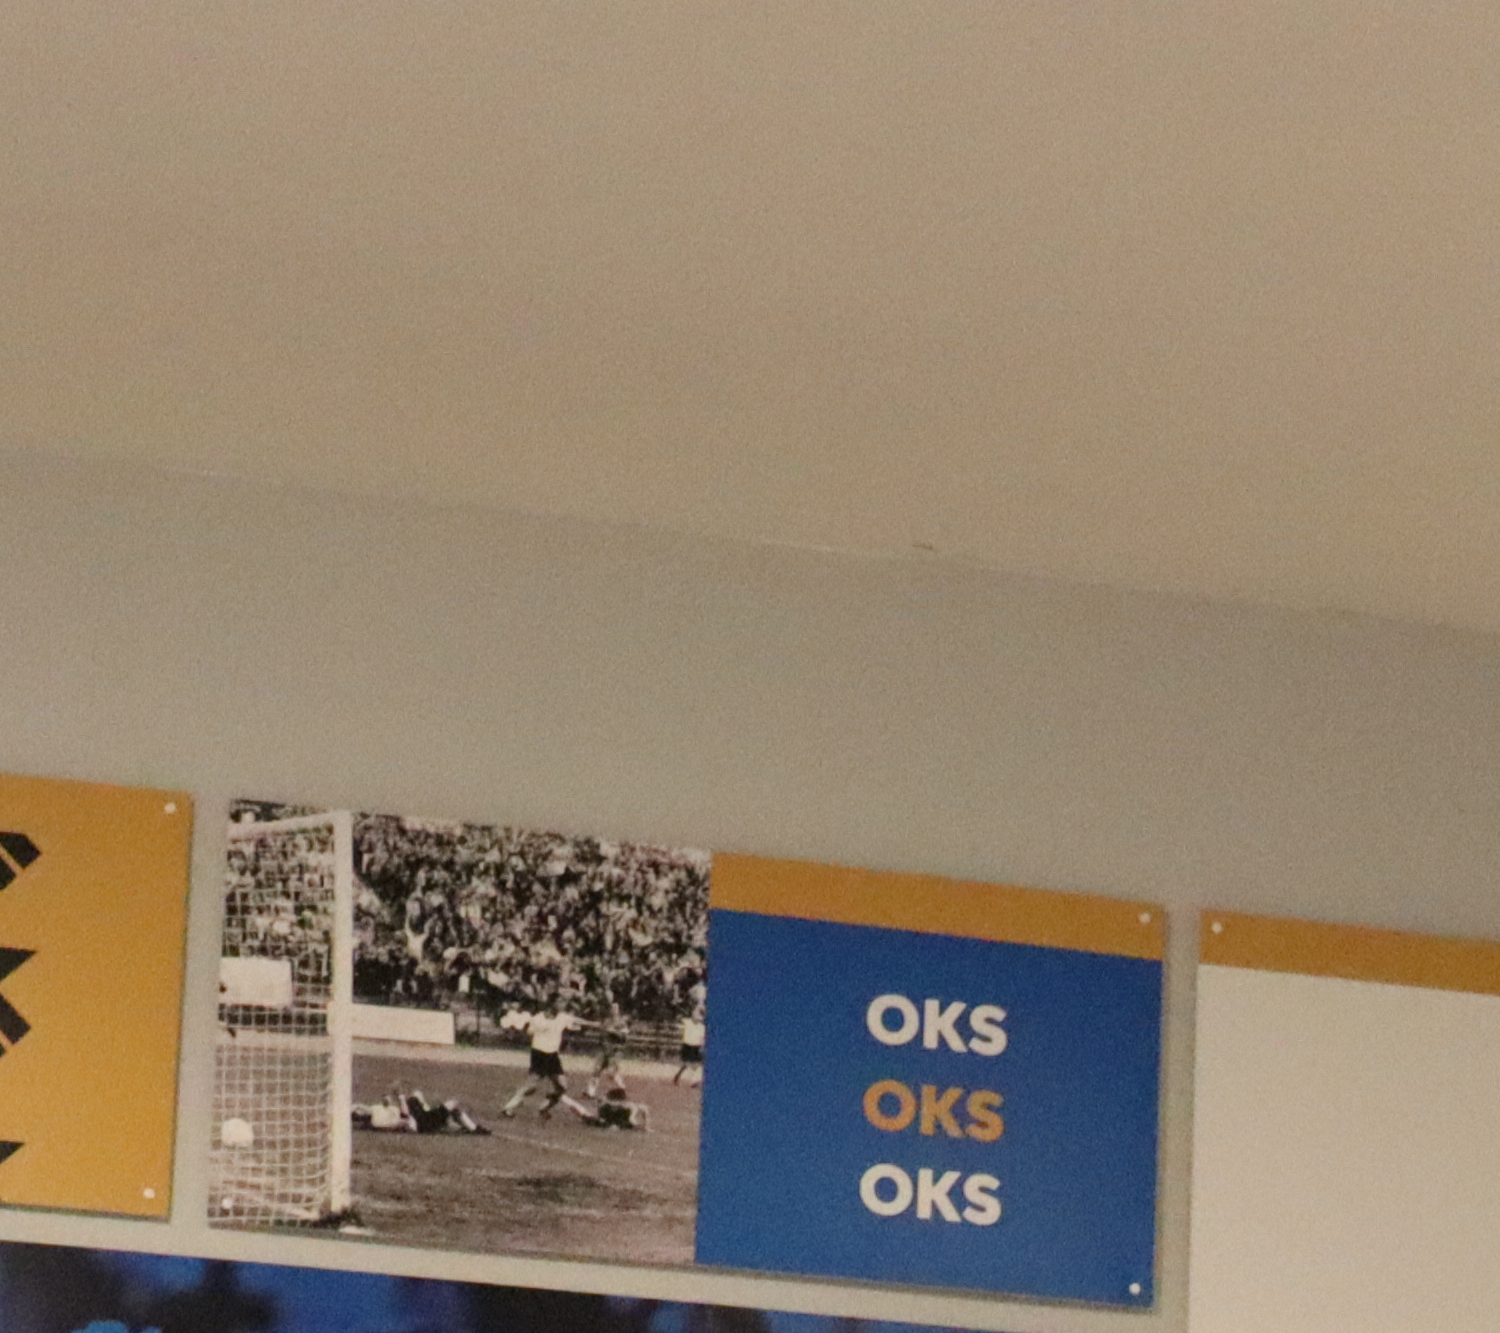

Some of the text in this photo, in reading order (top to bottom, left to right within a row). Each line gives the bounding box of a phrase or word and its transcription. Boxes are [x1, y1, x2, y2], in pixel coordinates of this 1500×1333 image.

[866, 994, 1008, 1057] OKS
[862, 1079, 1005, 1143] OKS
[859, 1163, 1002, 1226] OKS
